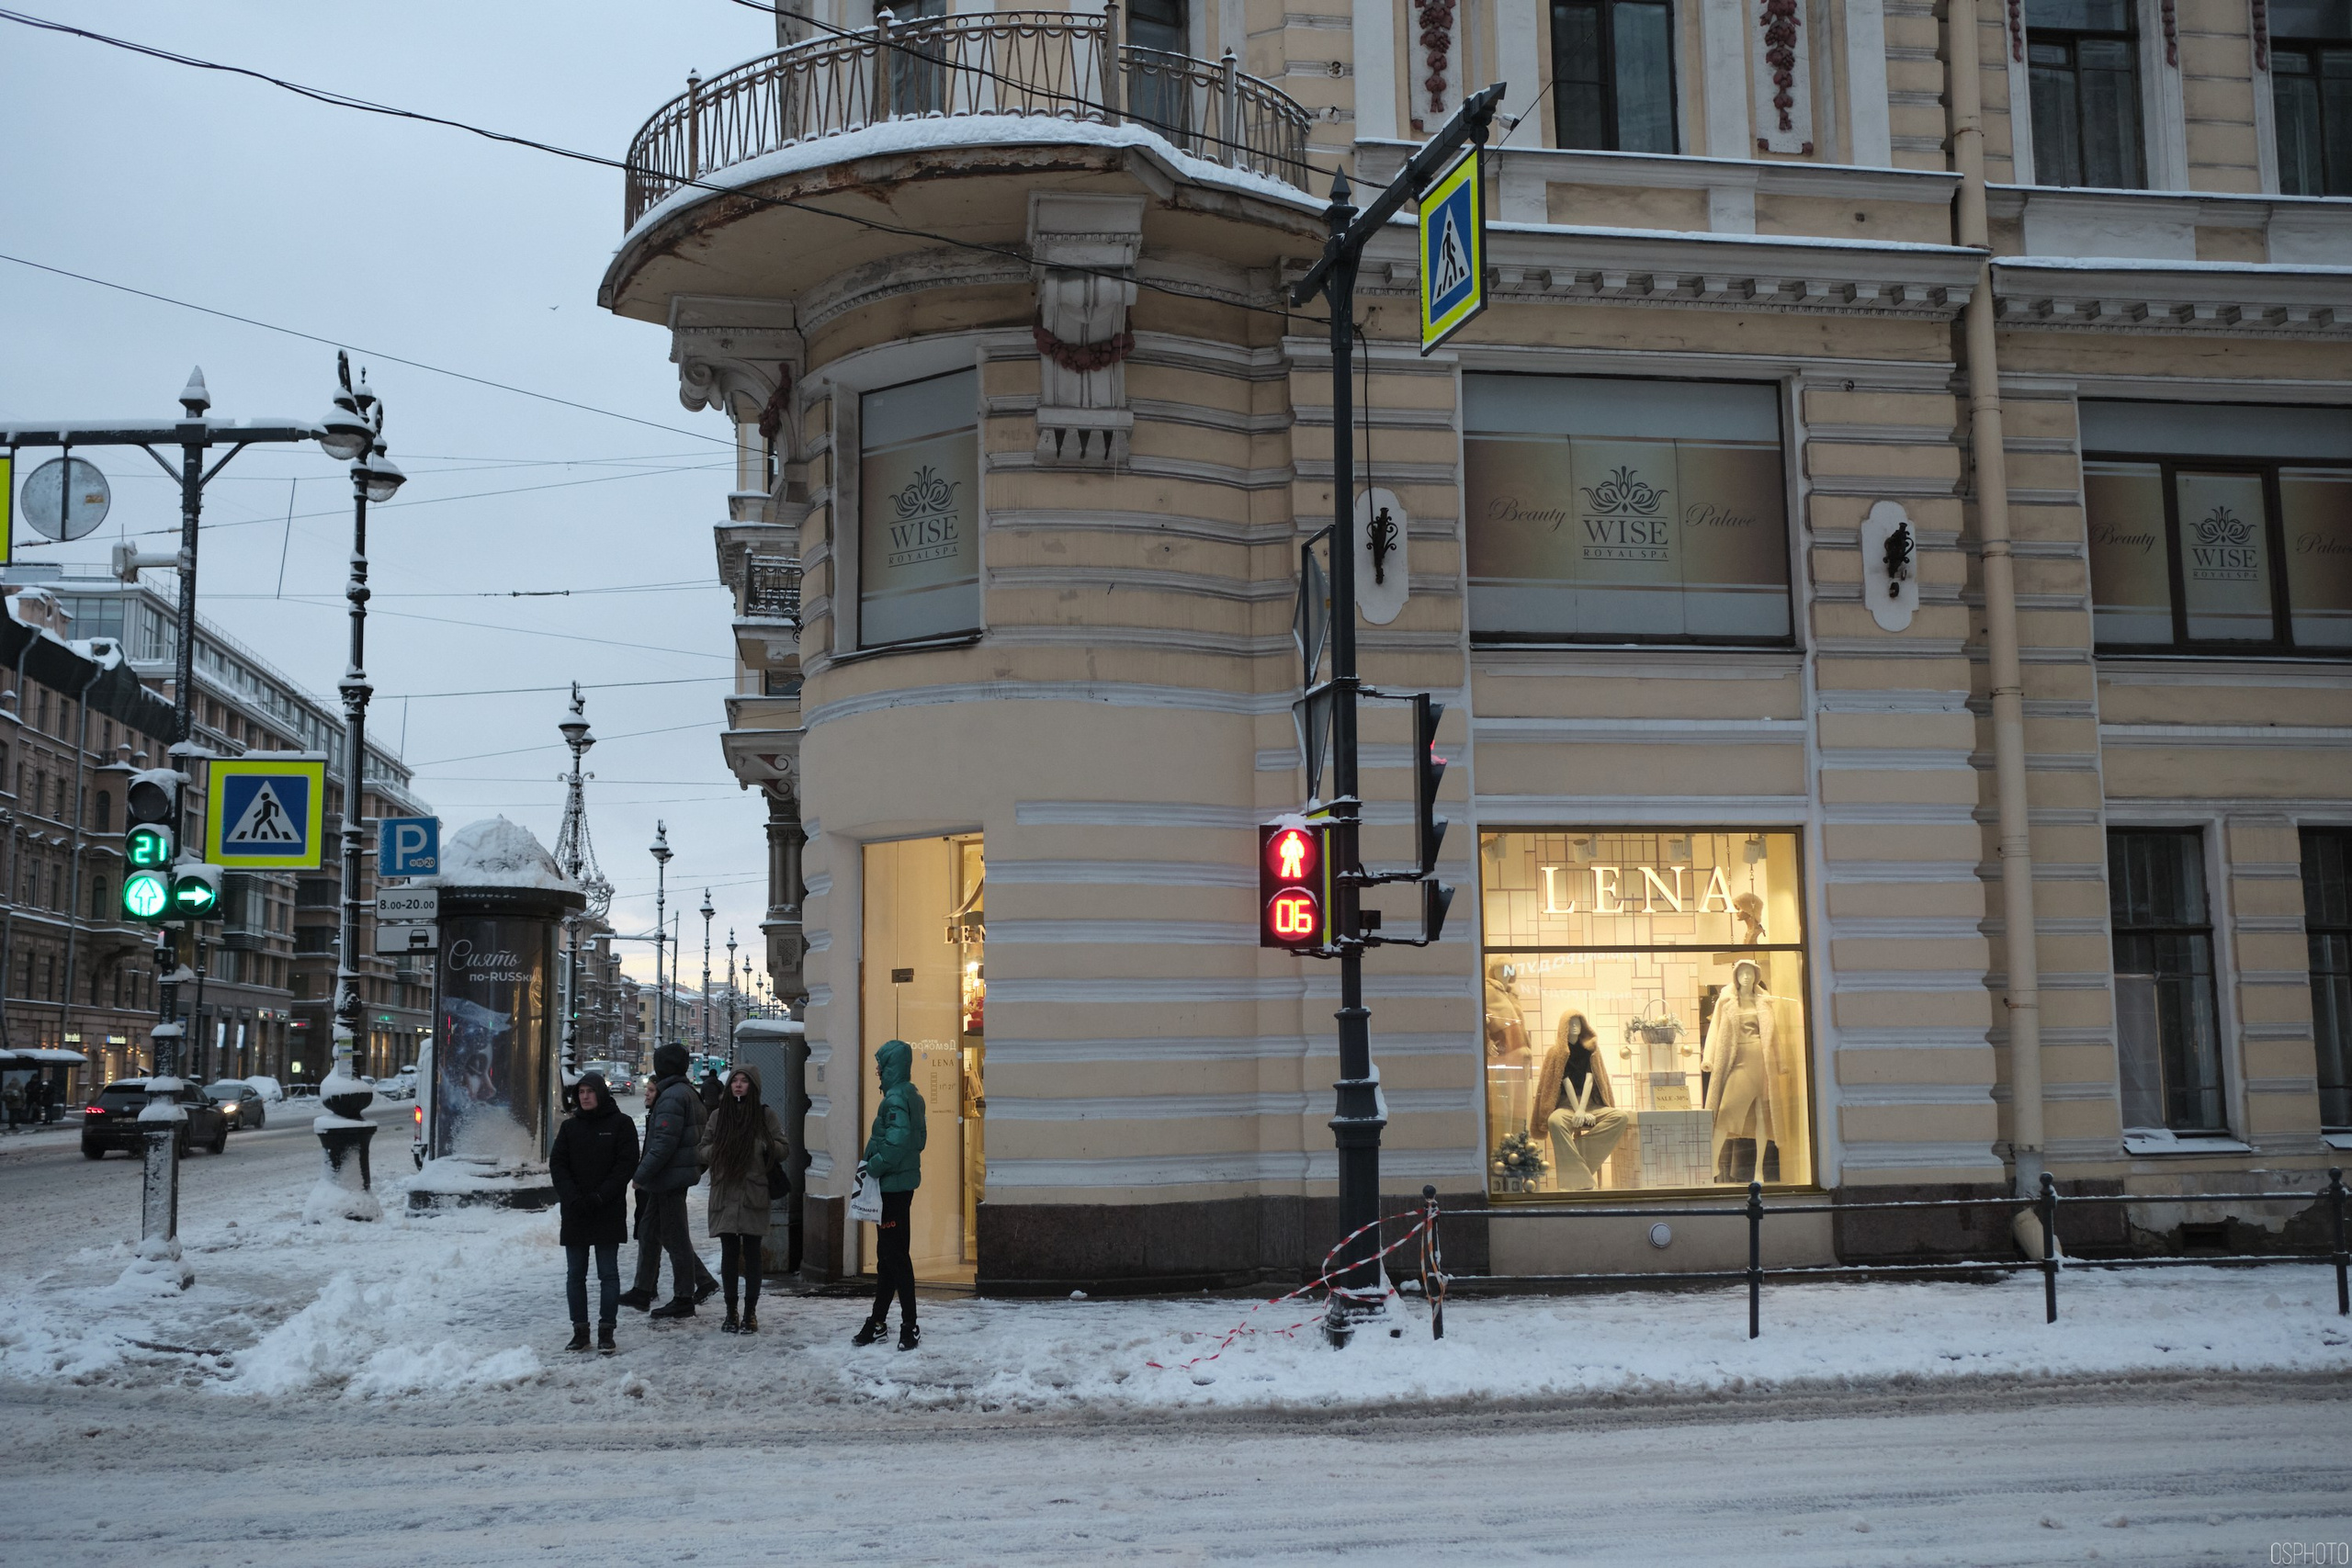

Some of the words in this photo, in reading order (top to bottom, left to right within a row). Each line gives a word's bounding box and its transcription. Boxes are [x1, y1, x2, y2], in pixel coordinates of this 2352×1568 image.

[1488, 496, 1567, 533] Beauty
[1685, 502, 1758, 529] Palace
[890, 515, 959, 549] WISE
[1583, 519, 1668, 546] WISE
[2090, 522, 2156, 555] Beauty
[888, 550, 930, 565] ROYAL
[935, 545, 958, 557] SPA
[1583, 548, 1635, 558] ROYAL
[1641, 549, 1668, 559] SPA
[2192, 547, 2258, 569] WISE
[2193, 570, 2232, 579] ROYAL
[2236, 571, 2258, 580] SPA
[134, 836, 167, 863] 21
[424, 859, 435, 867] 20
[1540, 865, 1740, 915] LENA
[379, 899, 435, 910] 8.00-20.00
[1276, 899, 1312, 932] 06
[448, 939, 522, 971] Сиять
[932, 1058, 955, 1067] LENA
